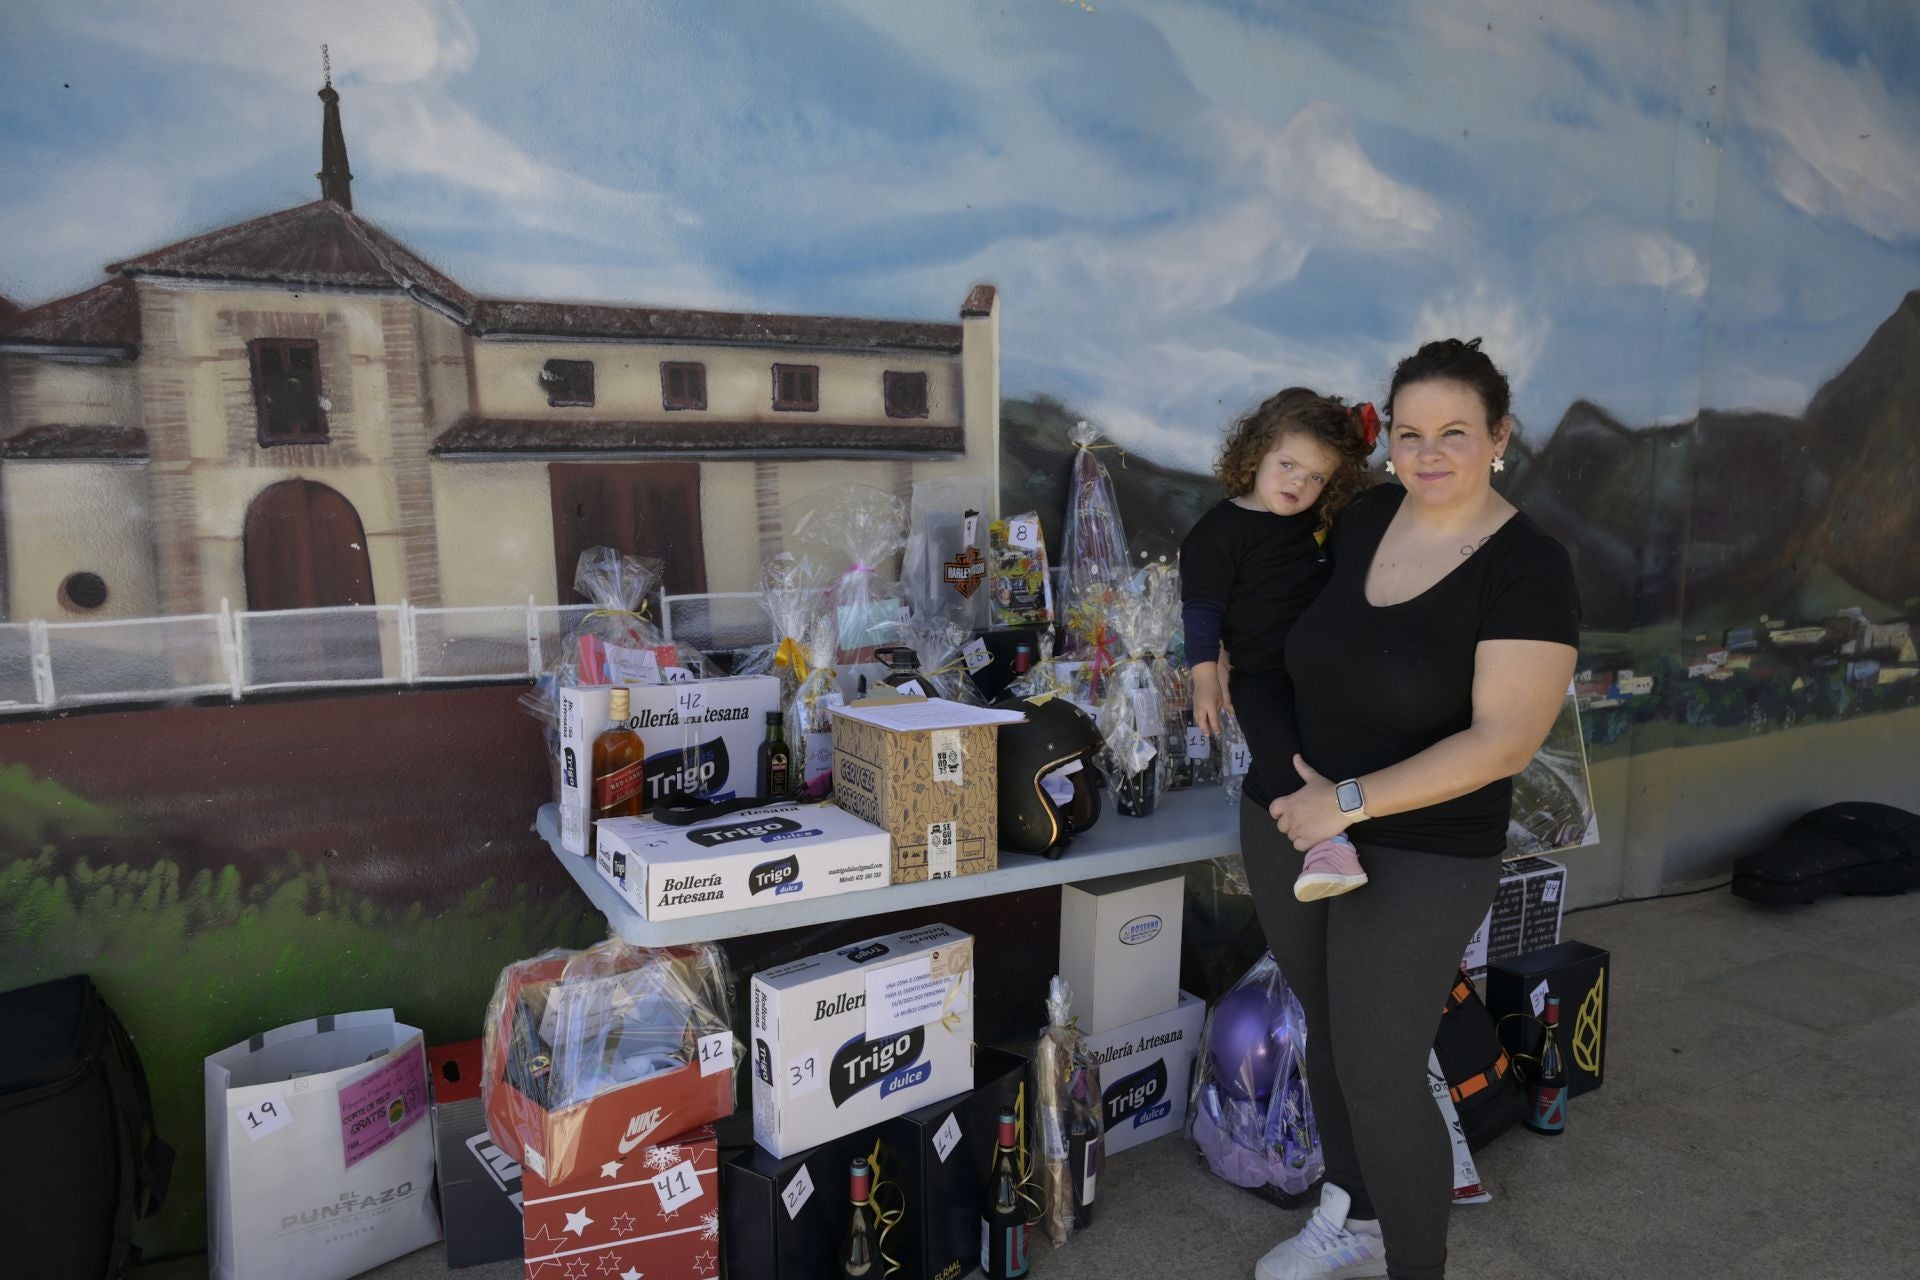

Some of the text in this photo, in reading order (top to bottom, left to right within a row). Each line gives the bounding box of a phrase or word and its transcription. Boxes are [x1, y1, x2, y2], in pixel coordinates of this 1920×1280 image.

[1016, 525, 1027, 541] 8
[680, 693, 701, 710] 42
[629, 708, 680, 729] ollería
[1189, 735, 1206, 747] 15
[647, 761, 715, 799] Trigo
[702, 822, 783, 841] Trigo
[772, 830, 813, 841] dulce
[663, 873, 723, 892] Bollería
[755, 866, 792, 887] Trigo
[657, 890, 725, 908] Artesana
[780, 885, 799, 893] dulce
[700, 1039, 723, 1062] 12
[1136, 1027, 1183, 1053] Artesana
[759, 1047, 770, 1081] Trigo
[843, 1034, 911, 1085] Trigo
[790, 1057, 815, 1087] 39
[889, 1070, 922, 1092] dulce
[1108, 1078, 1157, 1118] Trigo
[247, 1101, 278, 1129] 19
[350, 1106, 387, 1136] GRATIS
[628, 1106, 663, 1137] NIKE
[1139, 1105, 1165, 1125] dulce
[339, 1190, 360, 1201] EL
[658, 1170, 691, 1202] 41
[788, 1178, 807, 1209] 22
[281, 1181, 413, 1231] PUNTAZO
